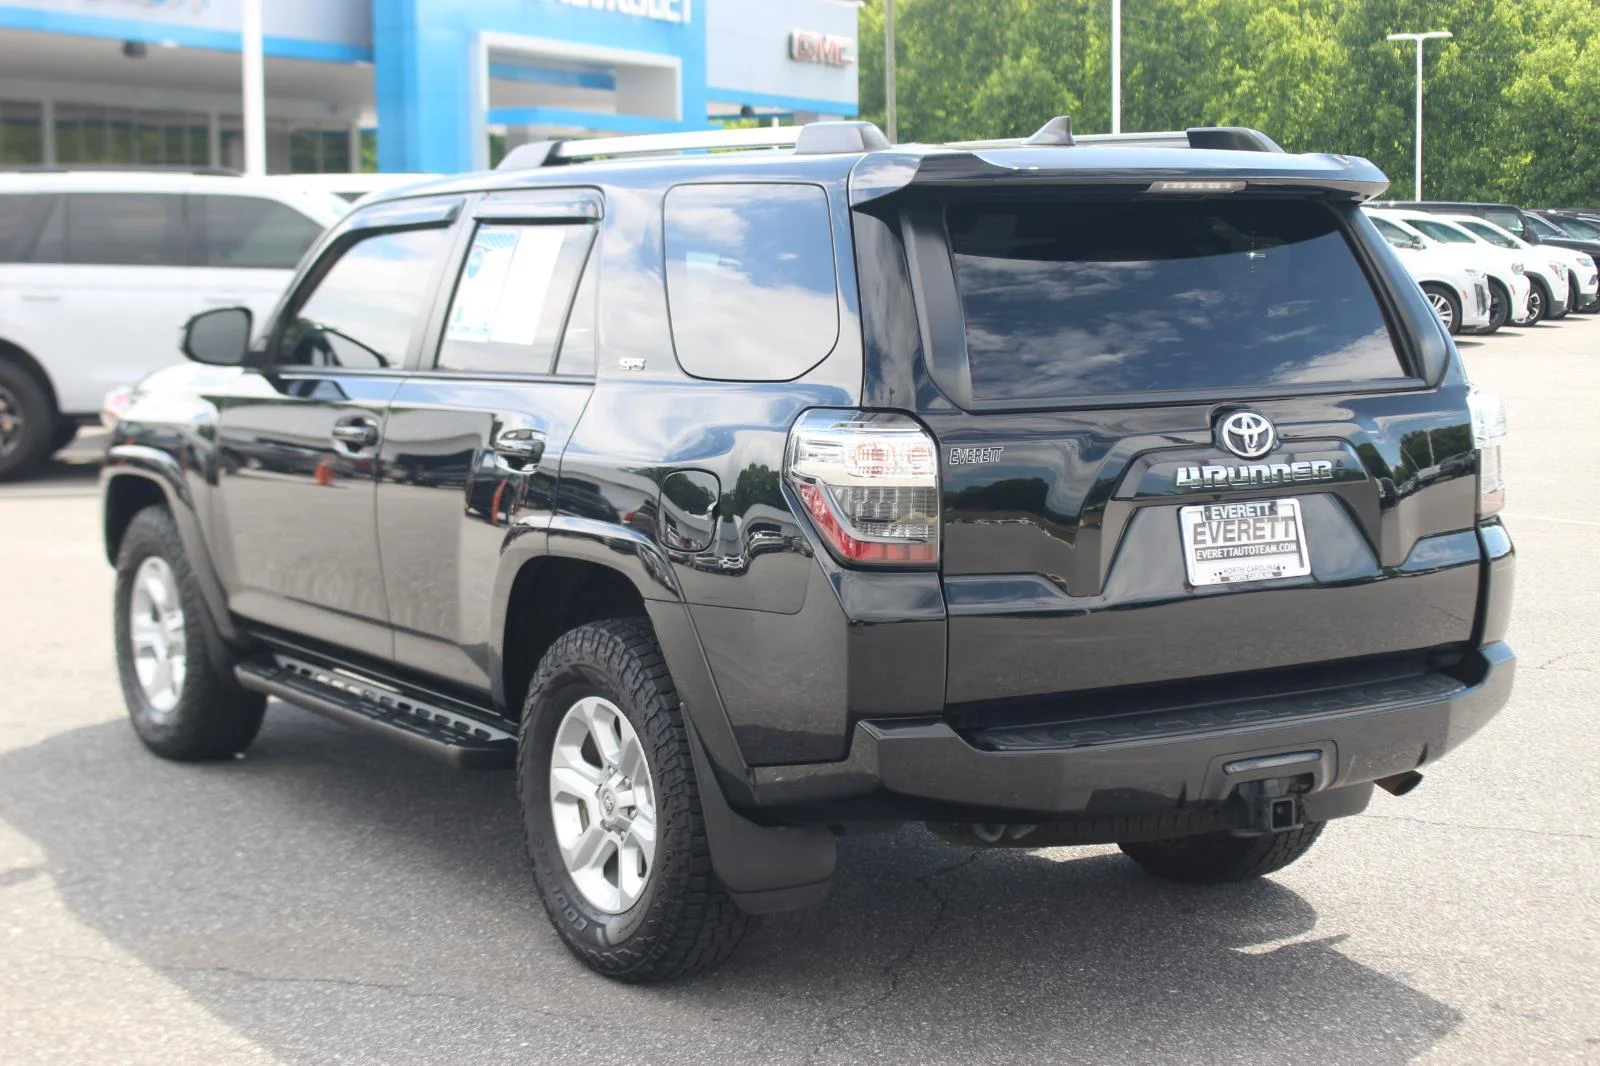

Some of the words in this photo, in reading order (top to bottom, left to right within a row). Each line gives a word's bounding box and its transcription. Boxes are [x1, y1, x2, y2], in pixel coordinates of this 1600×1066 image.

[949, 446, 1004, 465] EVERETT
[1176, 461, 1333, 488] 4RUNNER
[1211, 503, 1271, 519] EVERETT
[1193, 516, 1295, 545] EVERETT
[1196, 543, 1297, 560] EVERETTAUTOTEAM.COM
